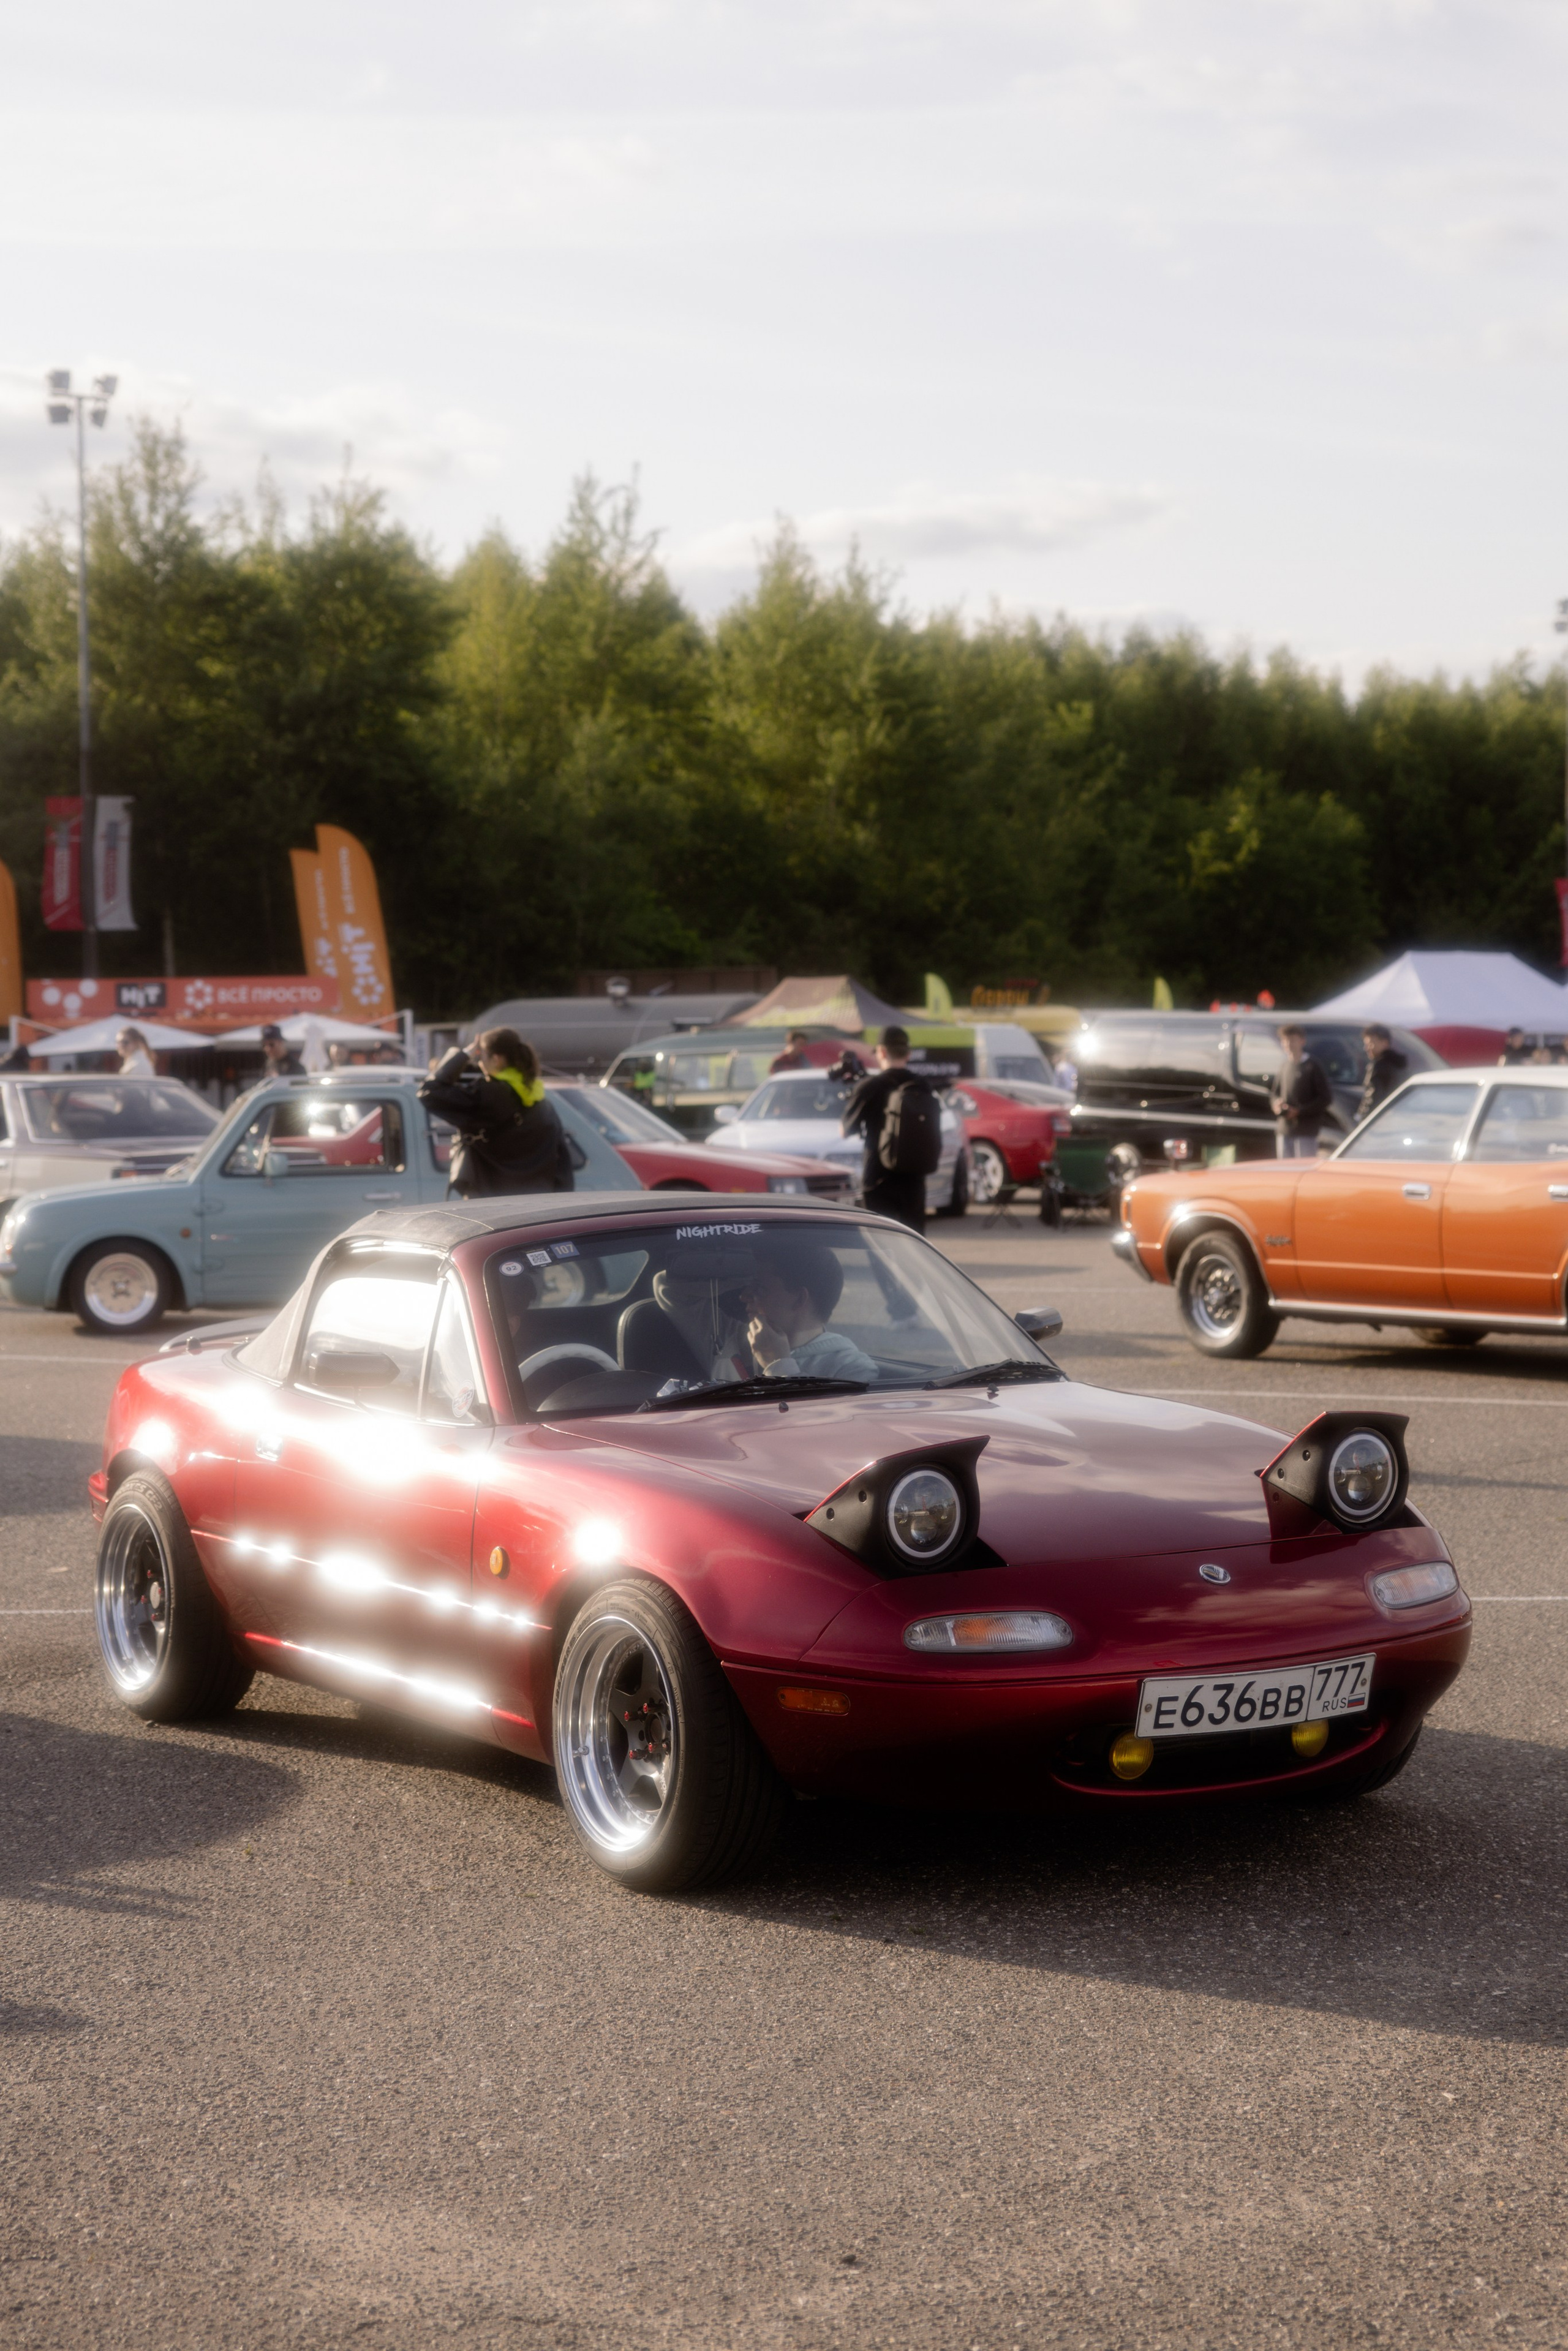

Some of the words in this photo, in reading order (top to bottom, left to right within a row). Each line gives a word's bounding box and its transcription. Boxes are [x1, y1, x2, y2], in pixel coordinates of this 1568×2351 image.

[217, 985, 248, 1003] ВСЁ
[252, 986, 323, 1003] ПРОСТО
[676, 1223, 764, 1240] NIGHTRIDE
[554, 1243, 575, 1256] 107
[1316, 1661, 1366, 1701] 777
[1322, 1697, 1348, 1713] RUS
